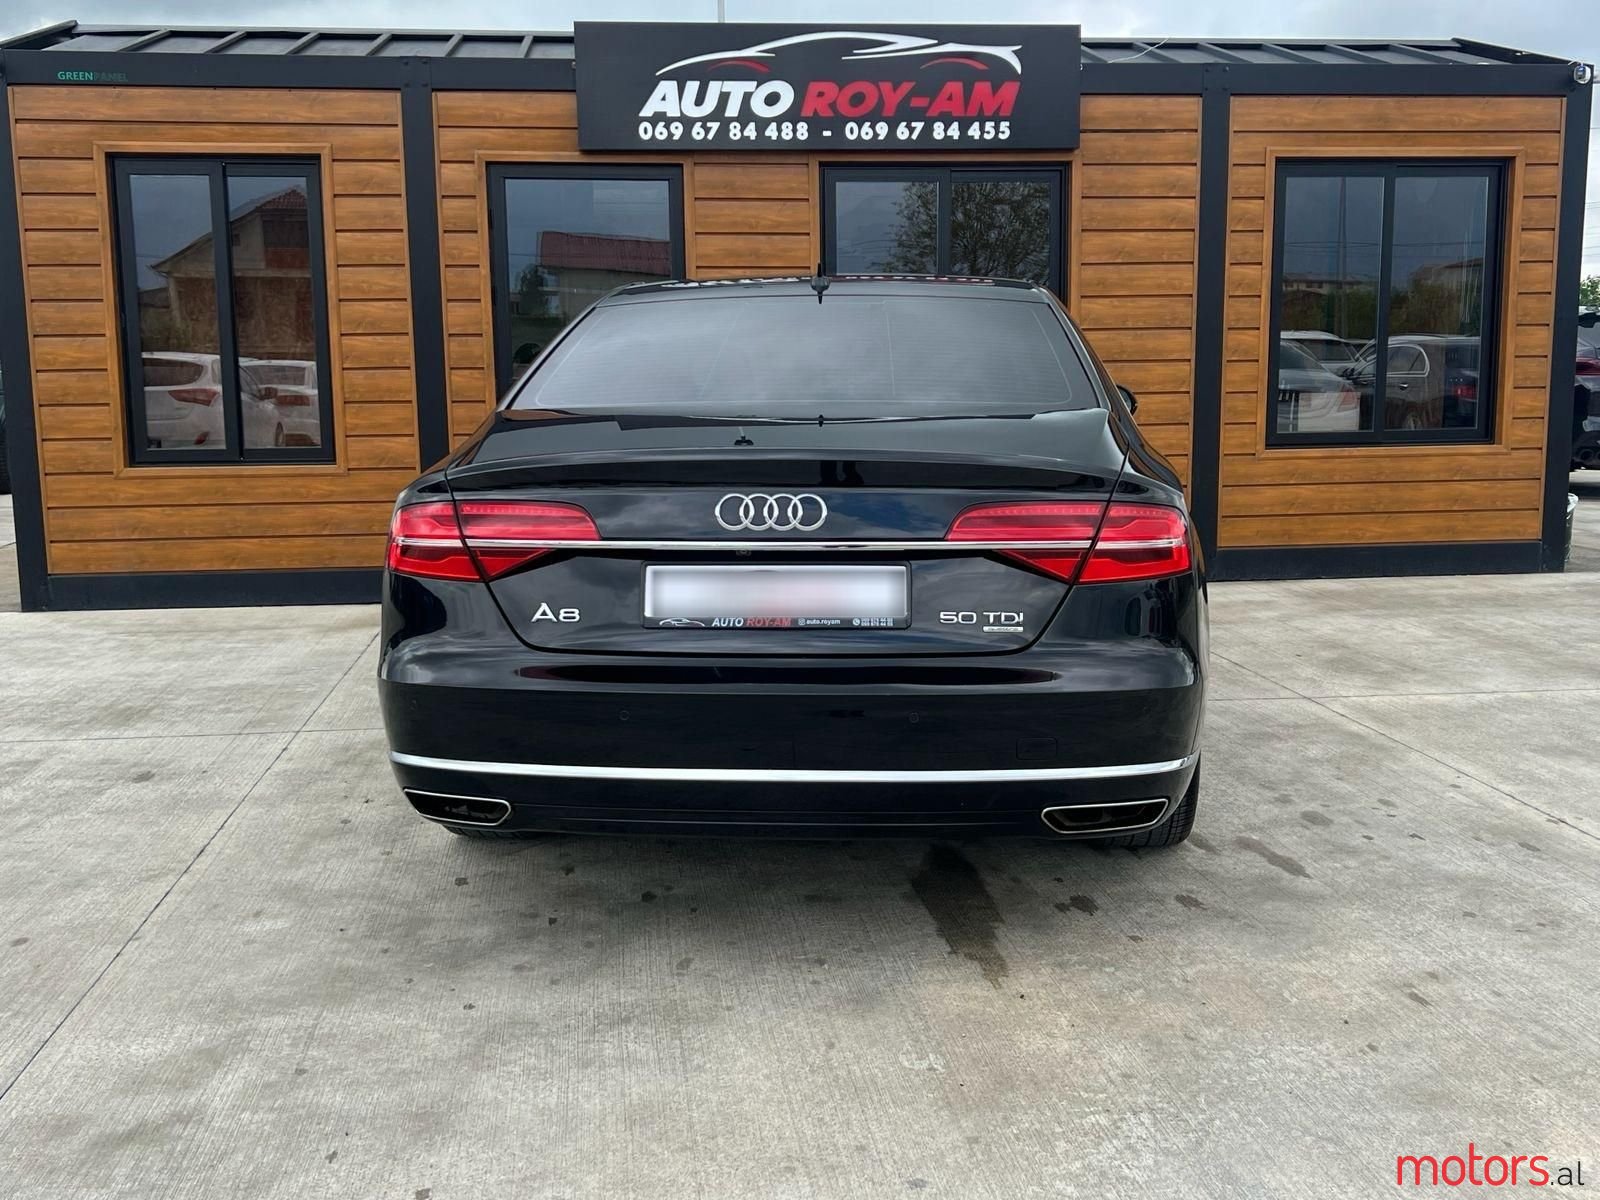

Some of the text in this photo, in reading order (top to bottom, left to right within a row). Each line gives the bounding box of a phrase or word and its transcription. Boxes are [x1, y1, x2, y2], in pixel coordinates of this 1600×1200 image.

[639, 80, 1021, 118] AUTO ROY-AM
[638, 121, 683, 141] 069
[691, 121, 718, 141] 67
[728, 121, 756, 141] 84
[764, 121, 809, 141] 488
[844, 121, 888, 141] 069
[896, 121, 923, 141] 67
[932, 121, 960, 141] 84
[967, 121, 1011, 141] 455
[530, 602, 580, 622] A8
[711, 617, 791, 627] AUTO ROY-AM
[940, 611, 1024, 625] 50 TDI
